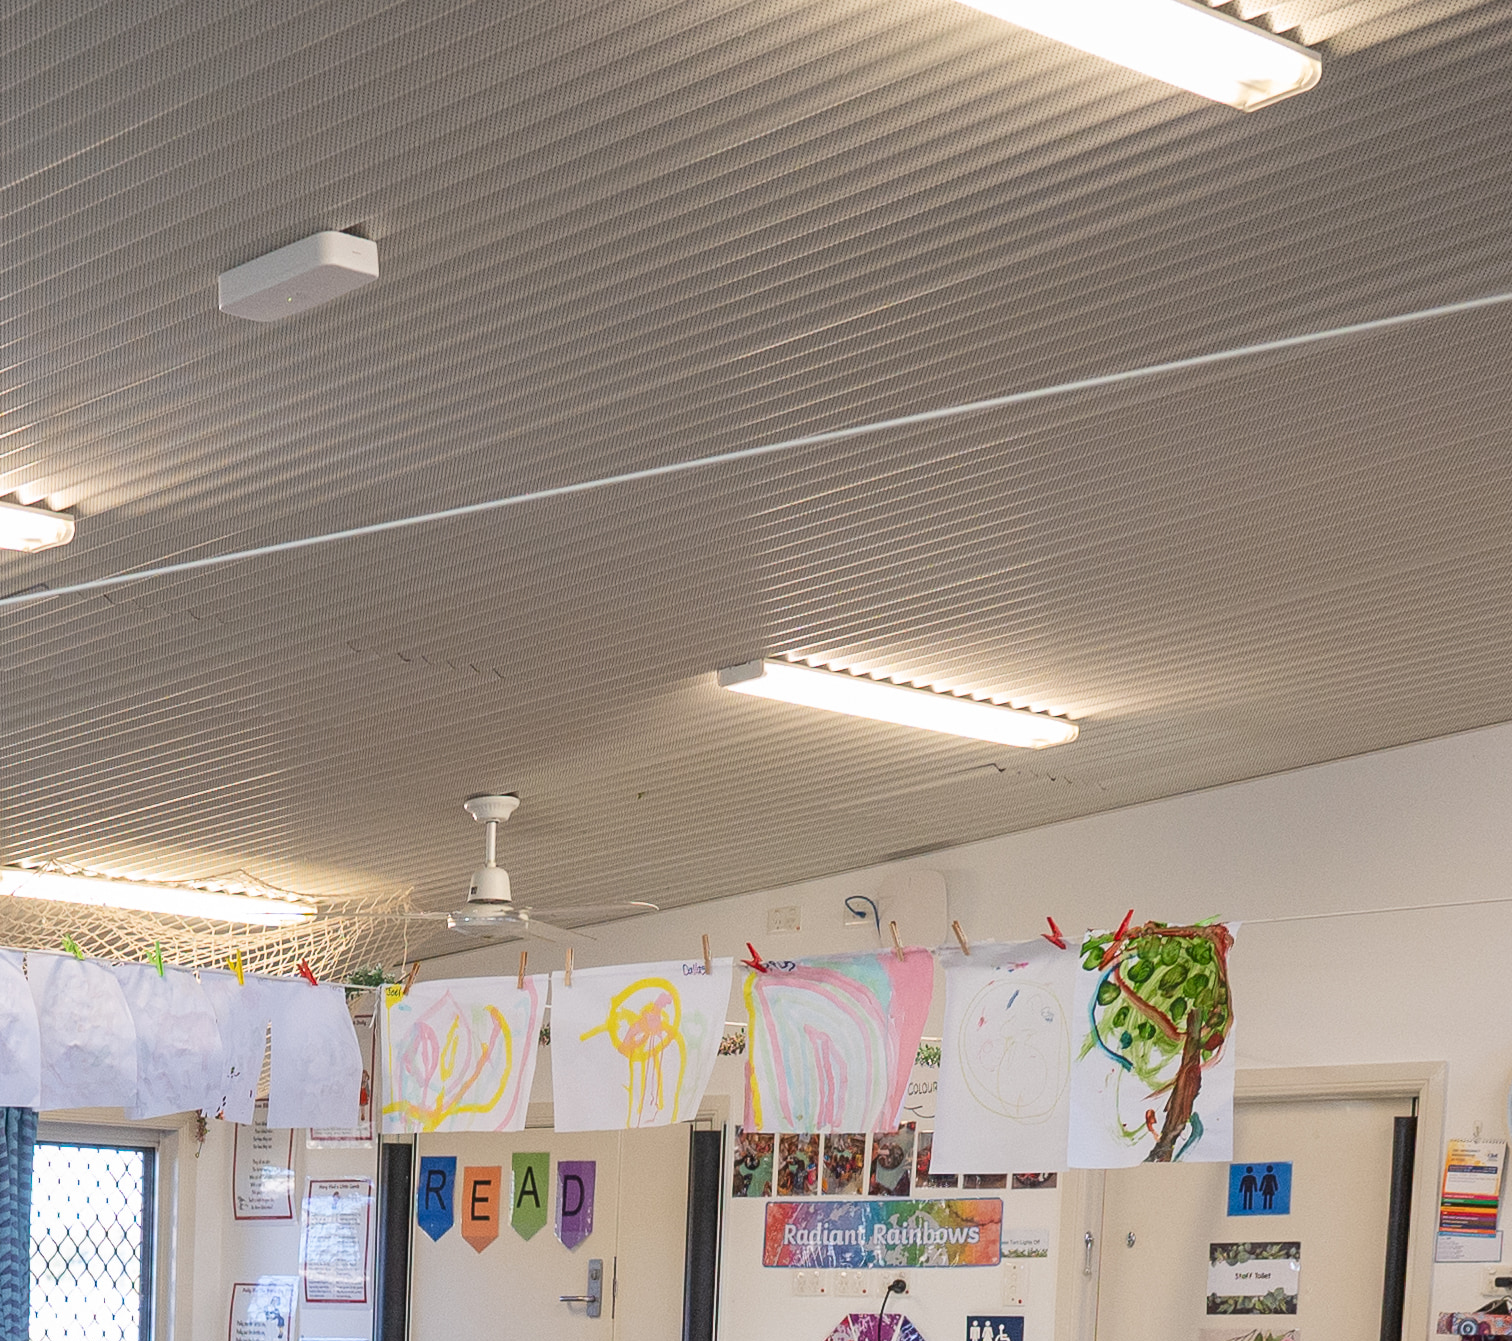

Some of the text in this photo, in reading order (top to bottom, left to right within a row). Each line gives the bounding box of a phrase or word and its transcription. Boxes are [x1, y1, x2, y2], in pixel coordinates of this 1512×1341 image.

[783, 1223, 981, 1246] Radiant Rainbows
[1235, 1272, 1253, 1280] Staff
